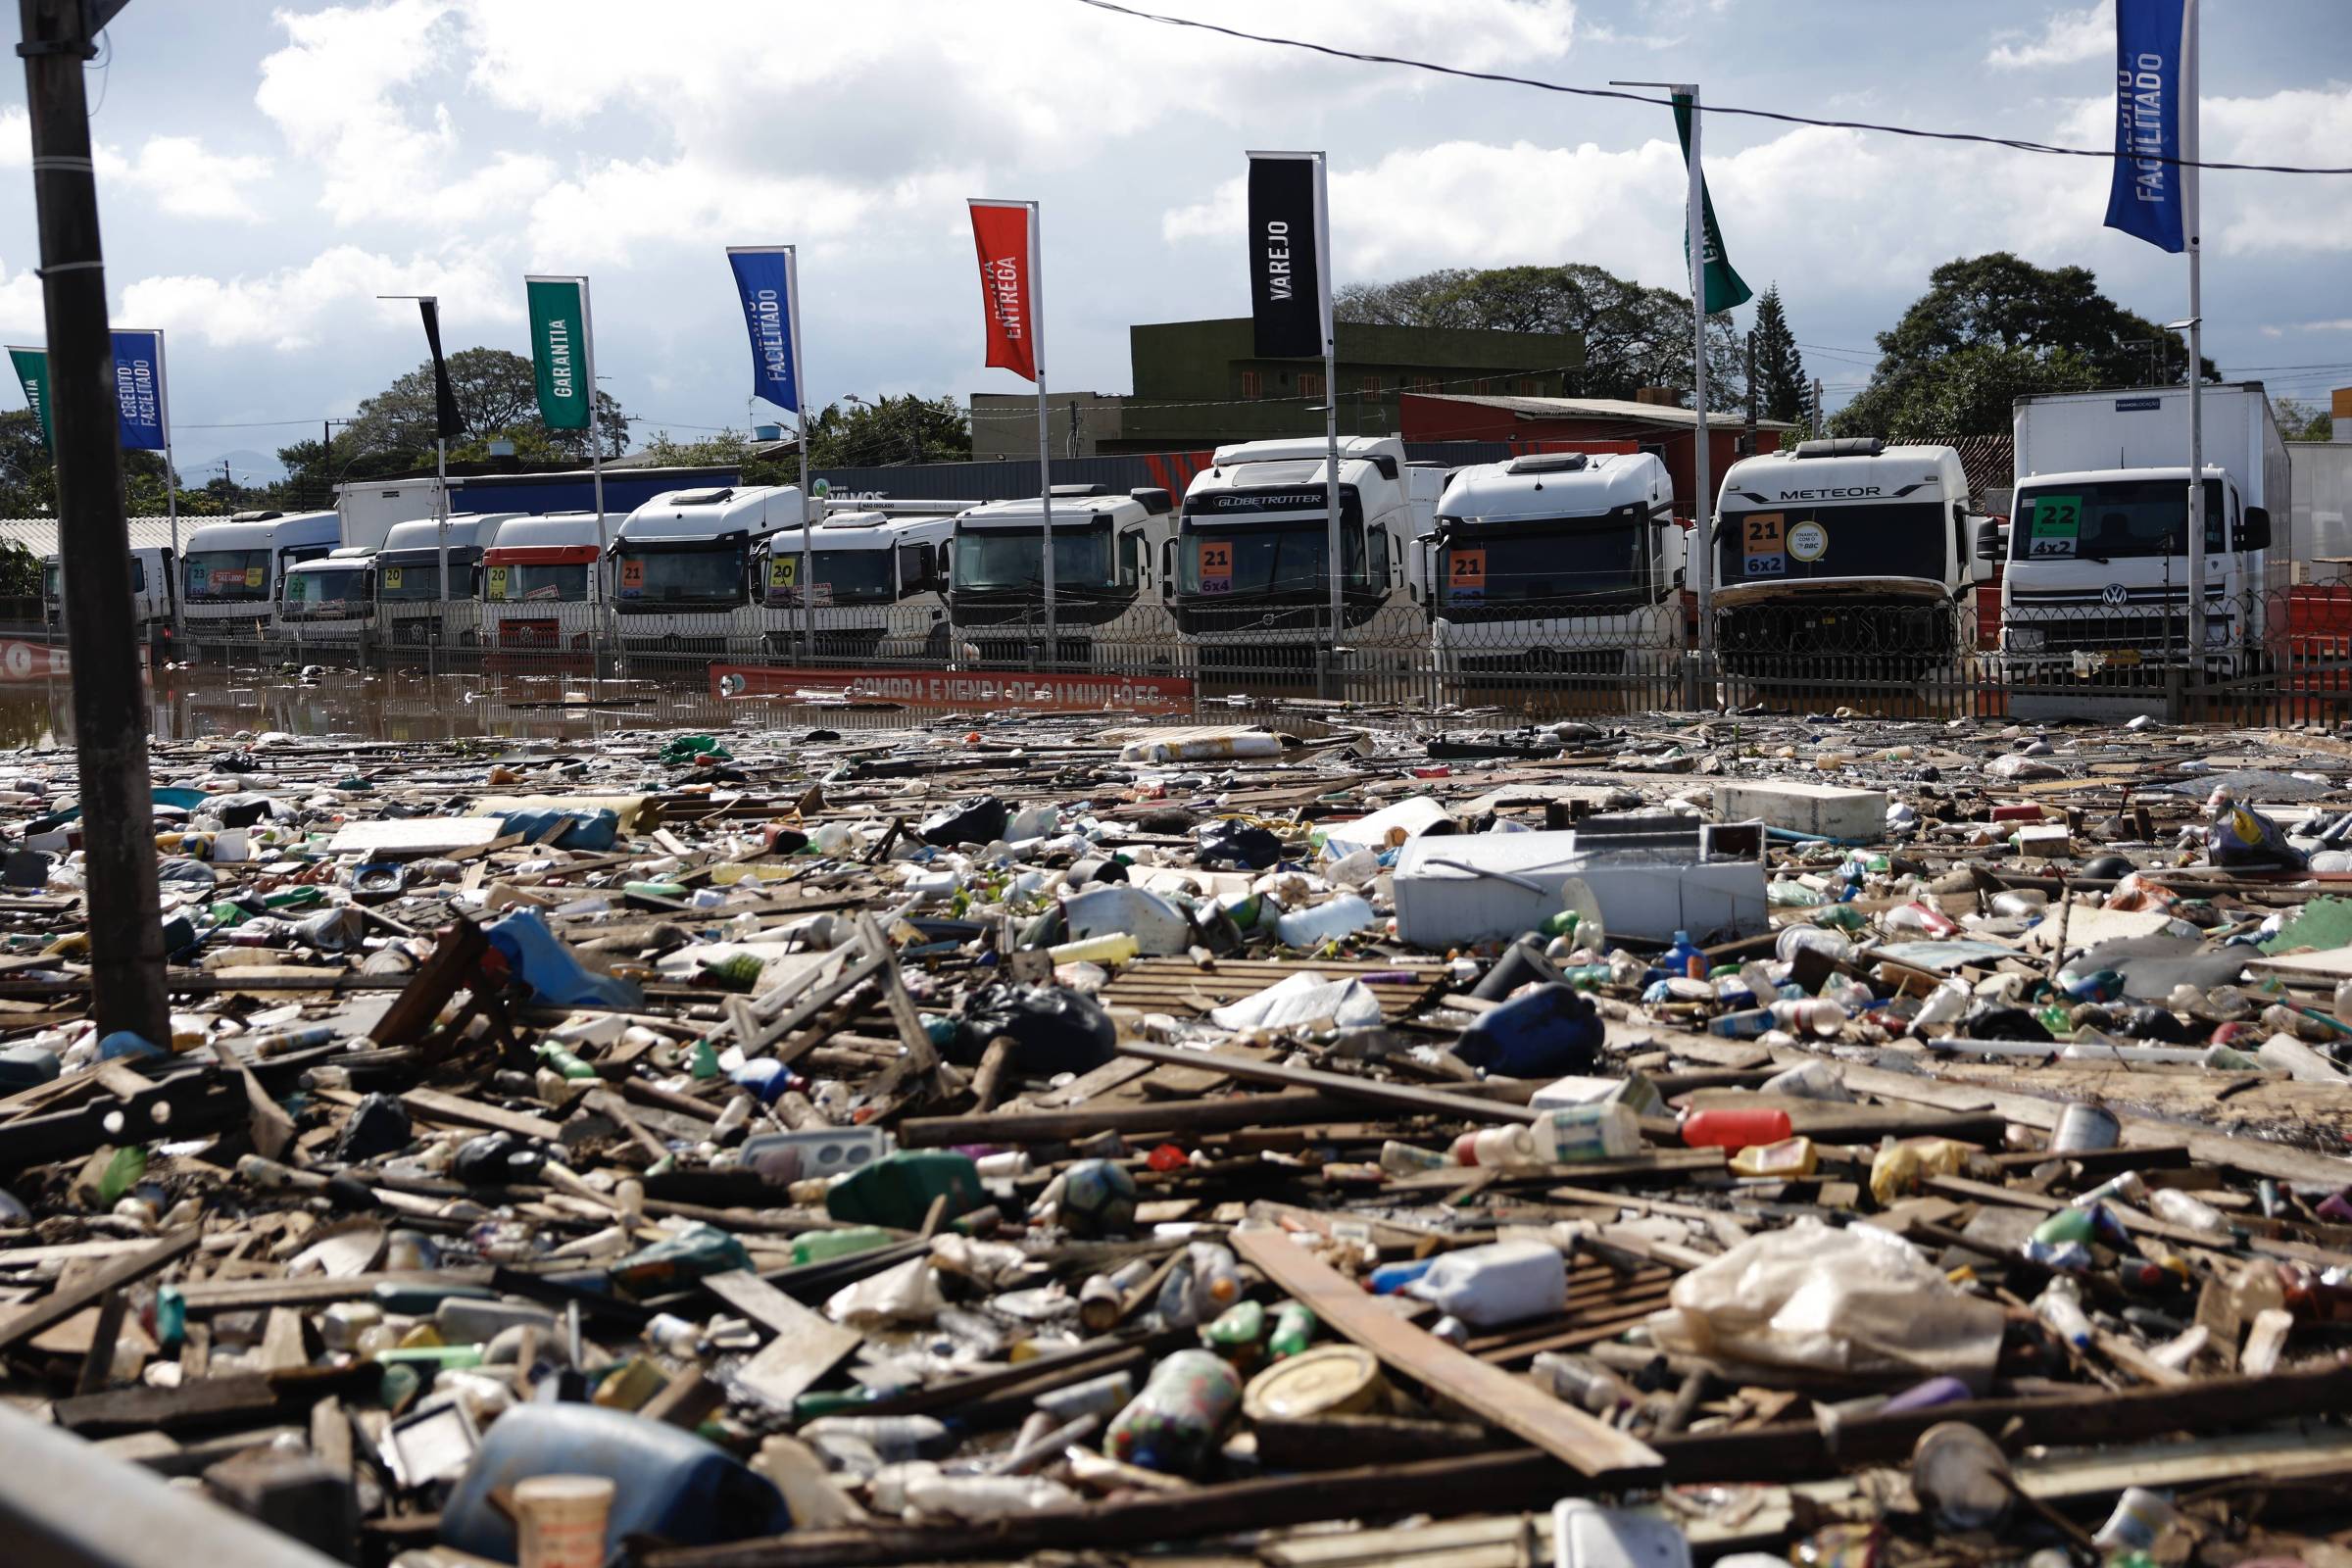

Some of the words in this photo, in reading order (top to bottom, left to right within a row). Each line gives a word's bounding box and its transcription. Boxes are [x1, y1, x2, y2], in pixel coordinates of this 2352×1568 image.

[2134, 53, 2165, 202] FACILITADO
[1267, 220, 1292, 301] VAREJO
[997, 256, 1021, 339] ENTREGA
[759, 289, 787, 381] FACILITADO
[549, 318, 573, 398] GARANTIA
[133, 359, 158, 427] FACILITADO
[1217, 494, 1322, 508] GLOBETROTTER
[1780, 486, 1881, 501] METEOR
[2041, 505, 2076, 524] 22
[1749, 521, 1780, 540] 21
[2033, 540, 2071, 555] 4x2
[1203, 551, 1229, 566] 21
[1747, 557, 1782, 572] 6x2
[625, 566, 642, 580] 21
[773, 564, 793, 578] 20
[1455, 559, 1481, 575] 21
[386, 569, 400, 581] 20
[492, 569, 506, 581] 20
[1201, 579, 1231, 592] 6x4
